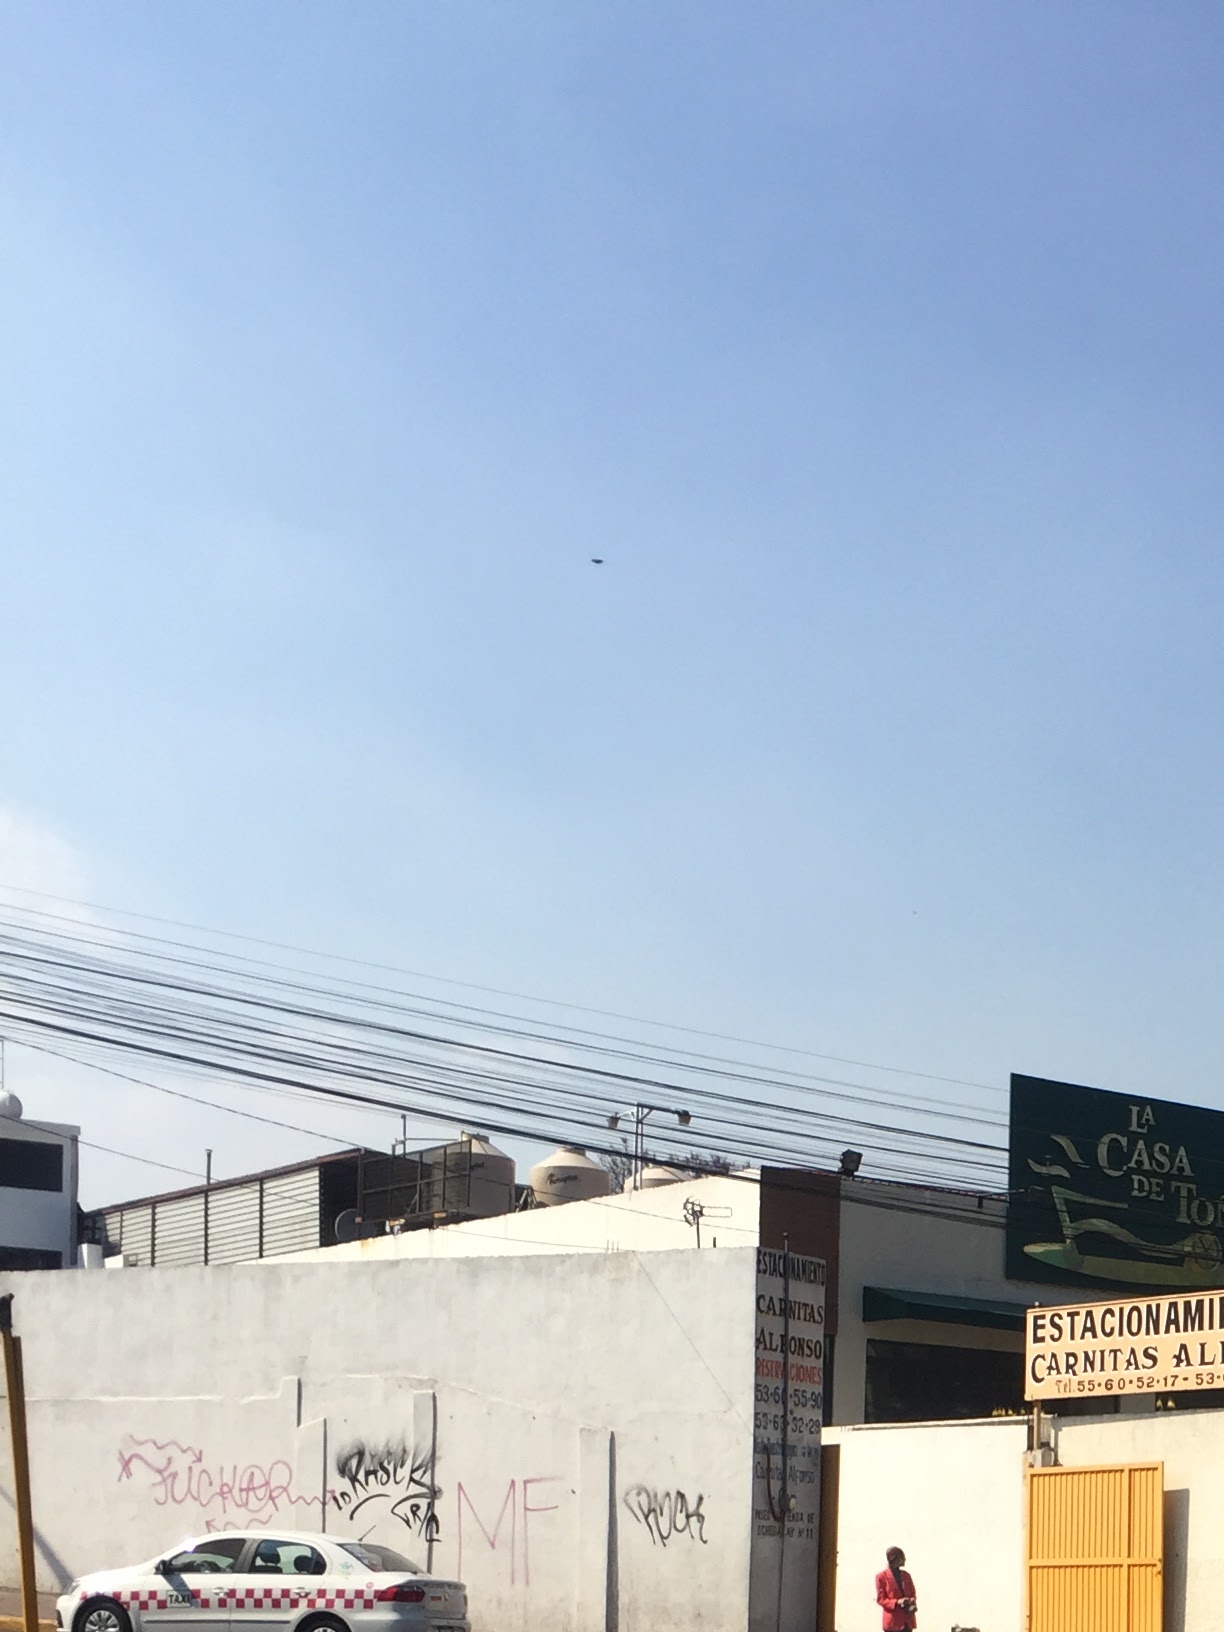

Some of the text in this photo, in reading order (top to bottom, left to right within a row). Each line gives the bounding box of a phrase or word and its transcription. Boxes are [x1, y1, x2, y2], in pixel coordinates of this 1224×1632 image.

[1129, 1105, 1156, 1133] LA
[1097, 1133, 1195, 1177] CASA
[1131, 1175, 1165, 1200] DE
[1031, 1345, 1158, 1383] CARNITAS
